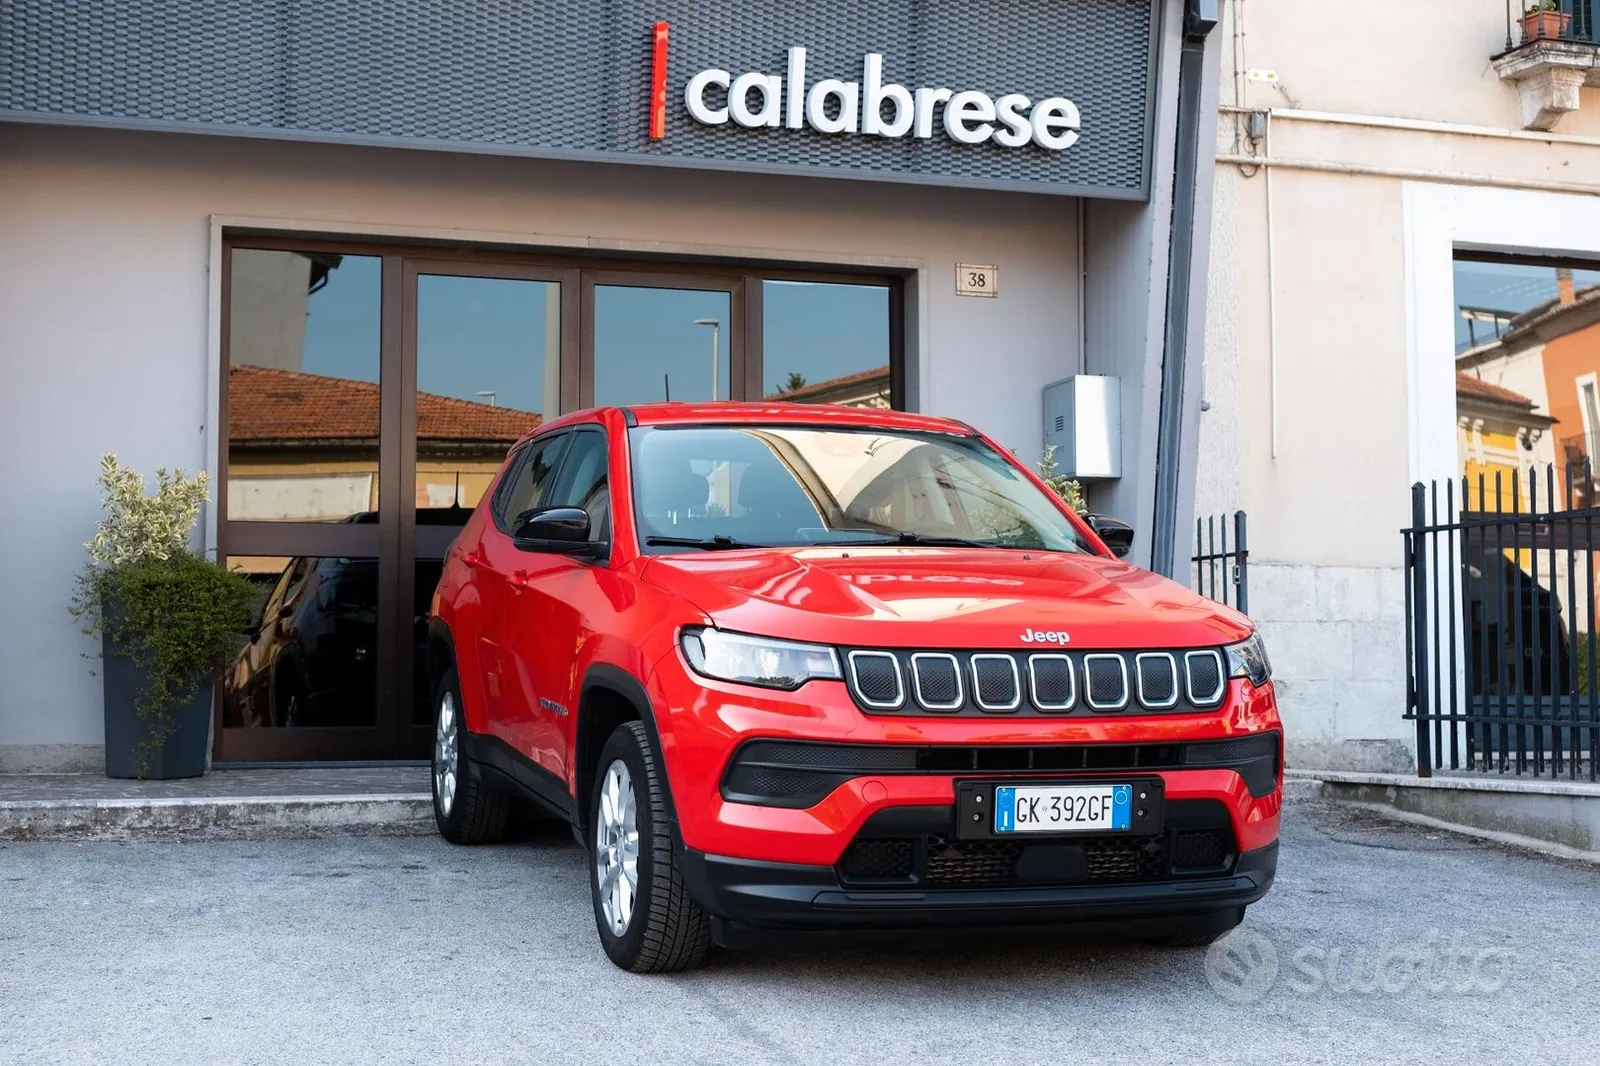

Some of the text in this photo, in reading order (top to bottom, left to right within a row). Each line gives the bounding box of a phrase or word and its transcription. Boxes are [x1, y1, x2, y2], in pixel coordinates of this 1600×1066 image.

[685, 46, 1081, 150] calabrese
[968, 272, 986, 288] 38
[1020, 628, 1070, 646] Jeep
[1016, 795, 1112, 823] GK 392GF
